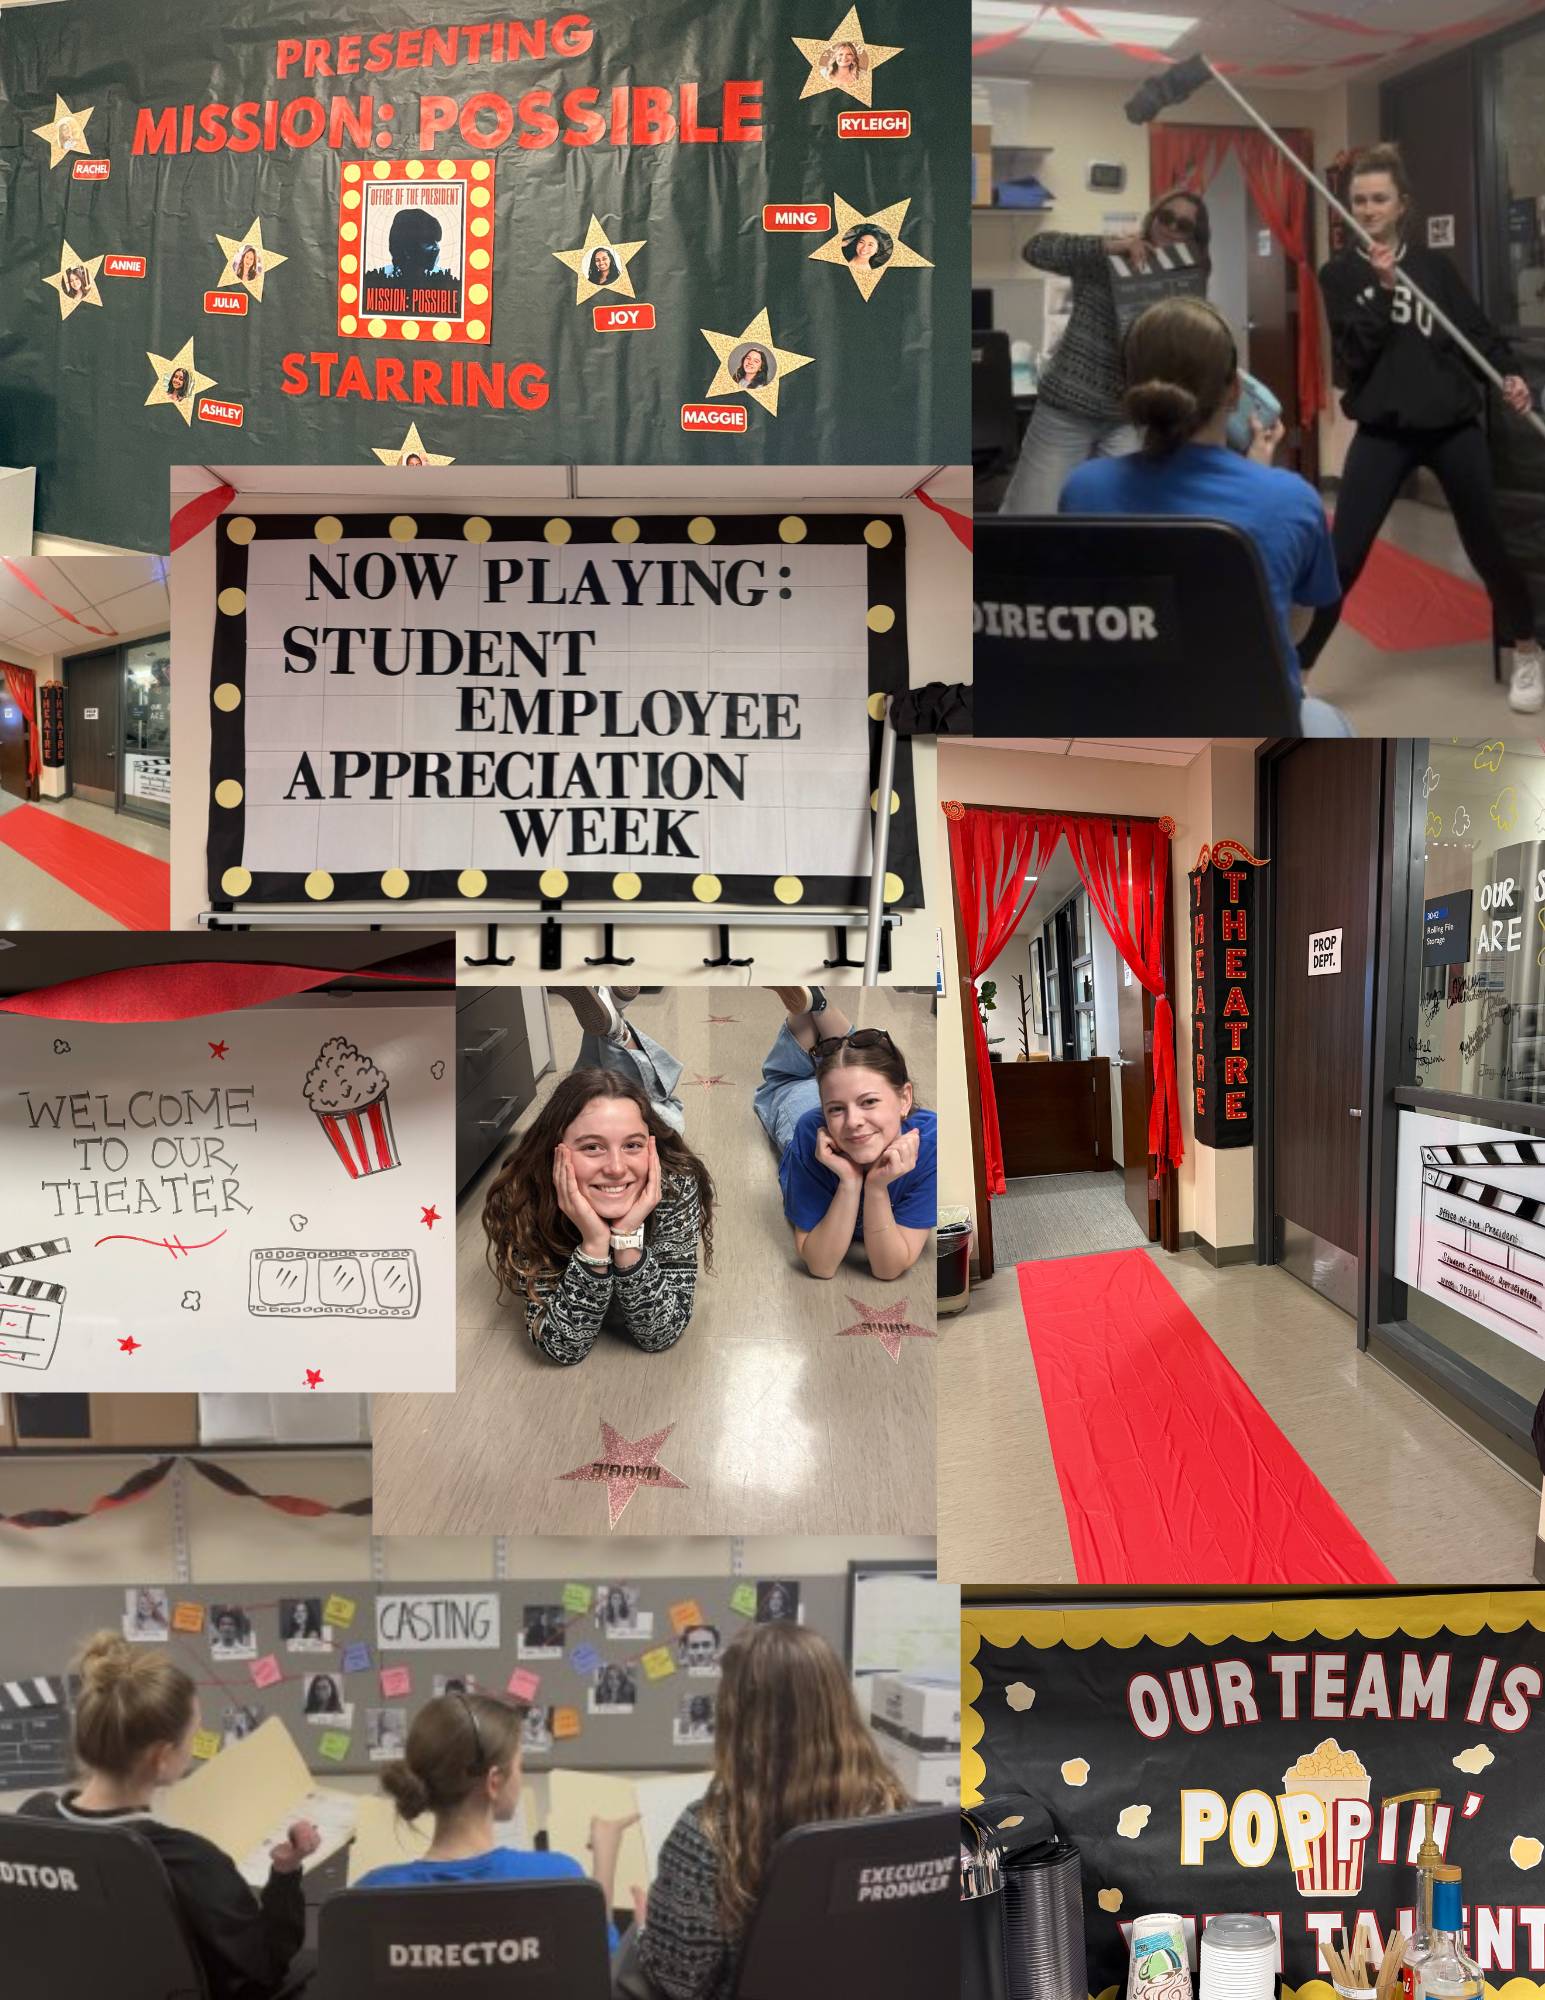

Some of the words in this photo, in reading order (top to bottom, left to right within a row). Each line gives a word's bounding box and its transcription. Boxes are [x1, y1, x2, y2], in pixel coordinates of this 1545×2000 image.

[277, 15, 593, 80] PRESENTING
[132, 96, 394, 156] MISSION:
[420, 80, 763, 151] POSSIBLE
[841, 117, 907, 132] RYLEIGH
[76, 163, 108, 176] RACHEL
[370, 188, 393, 206] OFFICE
[395, 188, 405, 206] OF
[406, 188, 420, 206] THE
[421, 188, 459, 206] PRESIDENT
[775, 211, 817, 226] MING
[110, 260, 141, 273] ANNIE
[212, 297, 240, 310] JULIA
[366, 287, 410, 312] MISSION:
[412, 288, 458, 314] POSSIBLE
[607, 310, 640, 325] JOY
[280, 351, 550, 411] STARRING
[201, 404, 241, 421] ASHLEY
[684, 410, 744, 427] MAGGIE
[305, 552, 458, 601] NOW
[484, 558, 792, 607] PLAYING:
[283, 625, 596, 678] STUDENT
[456, 687, 801, 740] EMPLOYEE
[283, 751, 749, 801] APPRECIATION
[500, 808, 700, 860] WEEK
[1481, 877, 1514, 911] OUR
[1313, 935, 1337, 952] PROP
[1477, 916, 1522, 954] ARE
[1313, 952, 1336, 968] DEPT.
[1194, 876, 1206, 1116] THEATRE
[1222, 871, 1249, 1120] THEATRE
[18, 1085, 257, 1132] WELCOME
[74, 1137, 129, 1172] TO
[151, 1137, 239, 1175] OUR
[42, 1173, 254, 1217] THEATER
[1485, 1222, 1519, 1242] President
[862, 1322, 910, 1334] ANNIE
[592, 1463, 661, 1480] MAGGIE
[380, 1600, 490, 1641] CASTING
[1127, 1658, 1261, 1740] OUR
[1268, 1652, 1453, 1721] TEAM
[1463, 1655, 1543, 1734] IS
[859, 1856, 957, 1884] EXECUTIVE
[857, 1874, 950, 1902] PRODUCER
[389, 1936, 540, 1967] DIRECTOR
